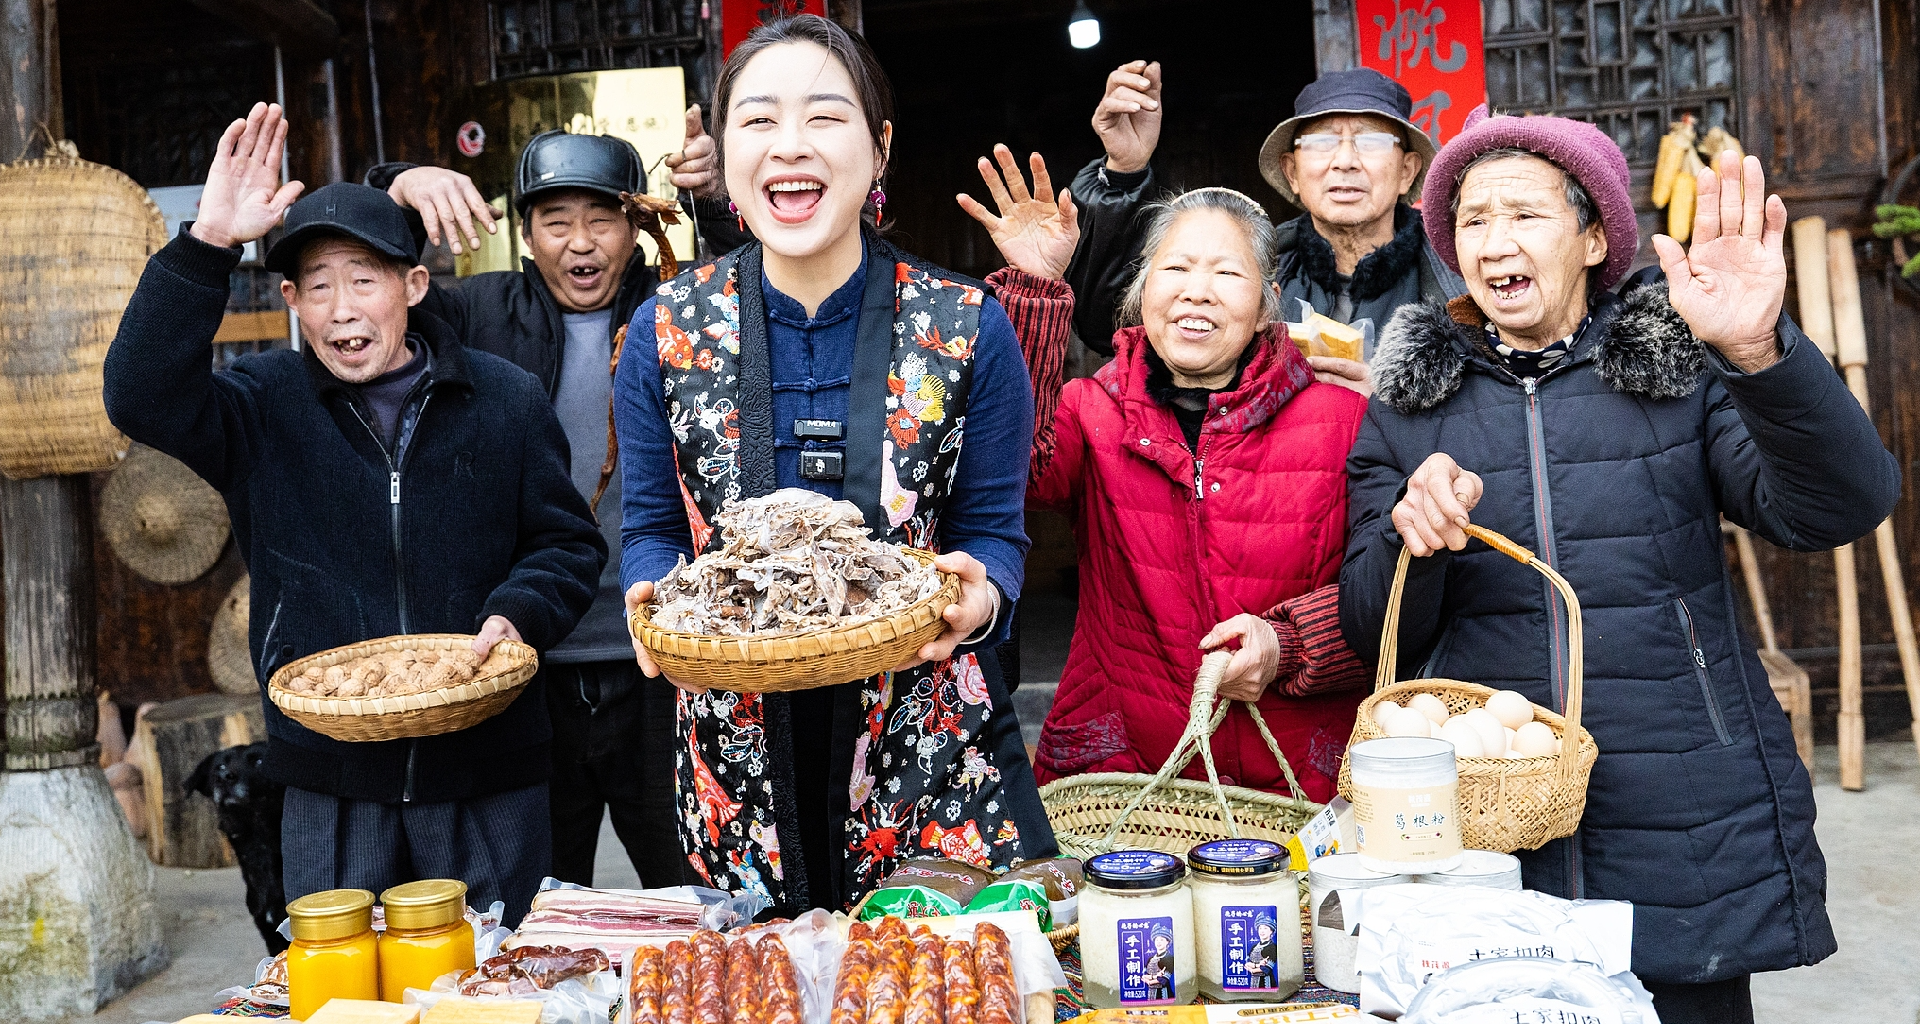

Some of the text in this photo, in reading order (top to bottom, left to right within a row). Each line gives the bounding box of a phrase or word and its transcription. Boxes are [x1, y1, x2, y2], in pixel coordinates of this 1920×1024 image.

[1395, 811, 1446, 830] 葛根粉
[1125, 934, 1141, 987] 手工制作
[1228, 922, 1244, 975] 手工制作
[1469, 944, 1554, 961] 土家扣肉
